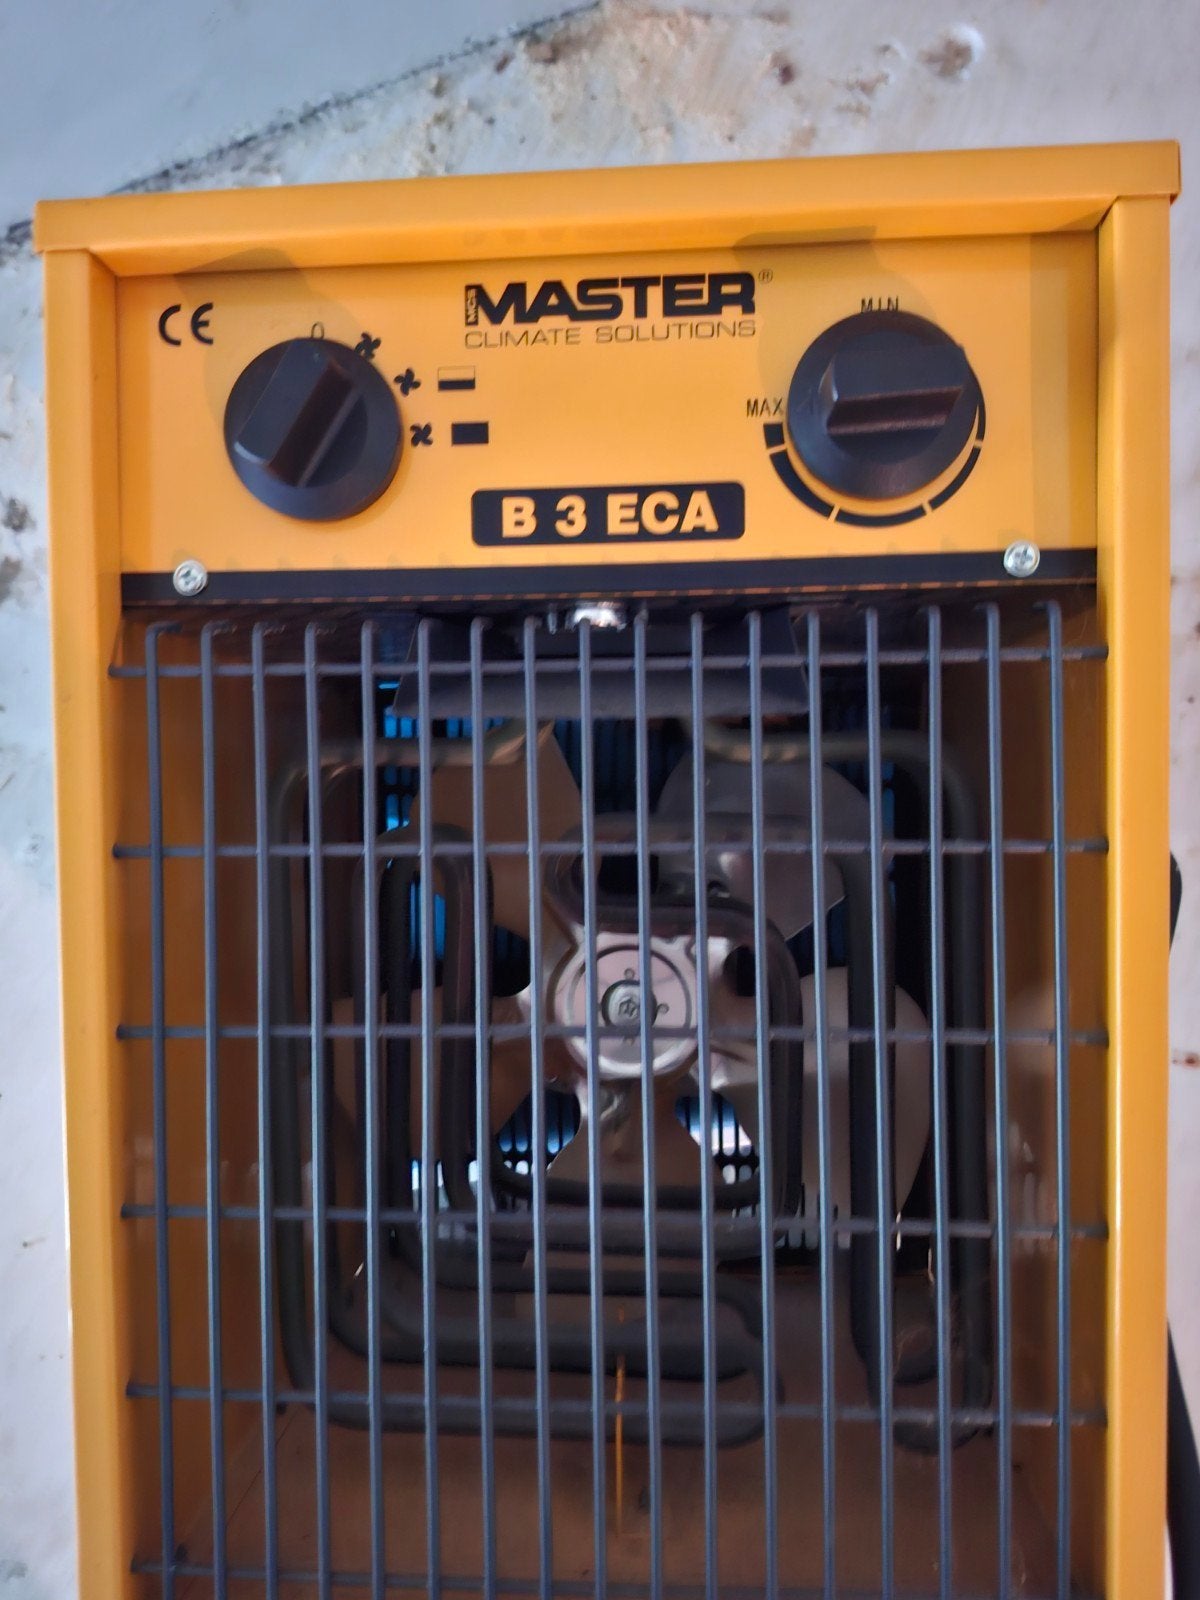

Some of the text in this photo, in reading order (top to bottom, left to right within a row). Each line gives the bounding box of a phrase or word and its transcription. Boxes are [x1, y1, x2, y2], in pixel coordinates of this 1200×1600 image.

[860, 296, 900, 313] MIN
[464, 319, 757, 349] CLIMATE SOLUTIONS
[746, 398, 784, 417] MAX
[502, 490, 719, 538] B 3 ECA
